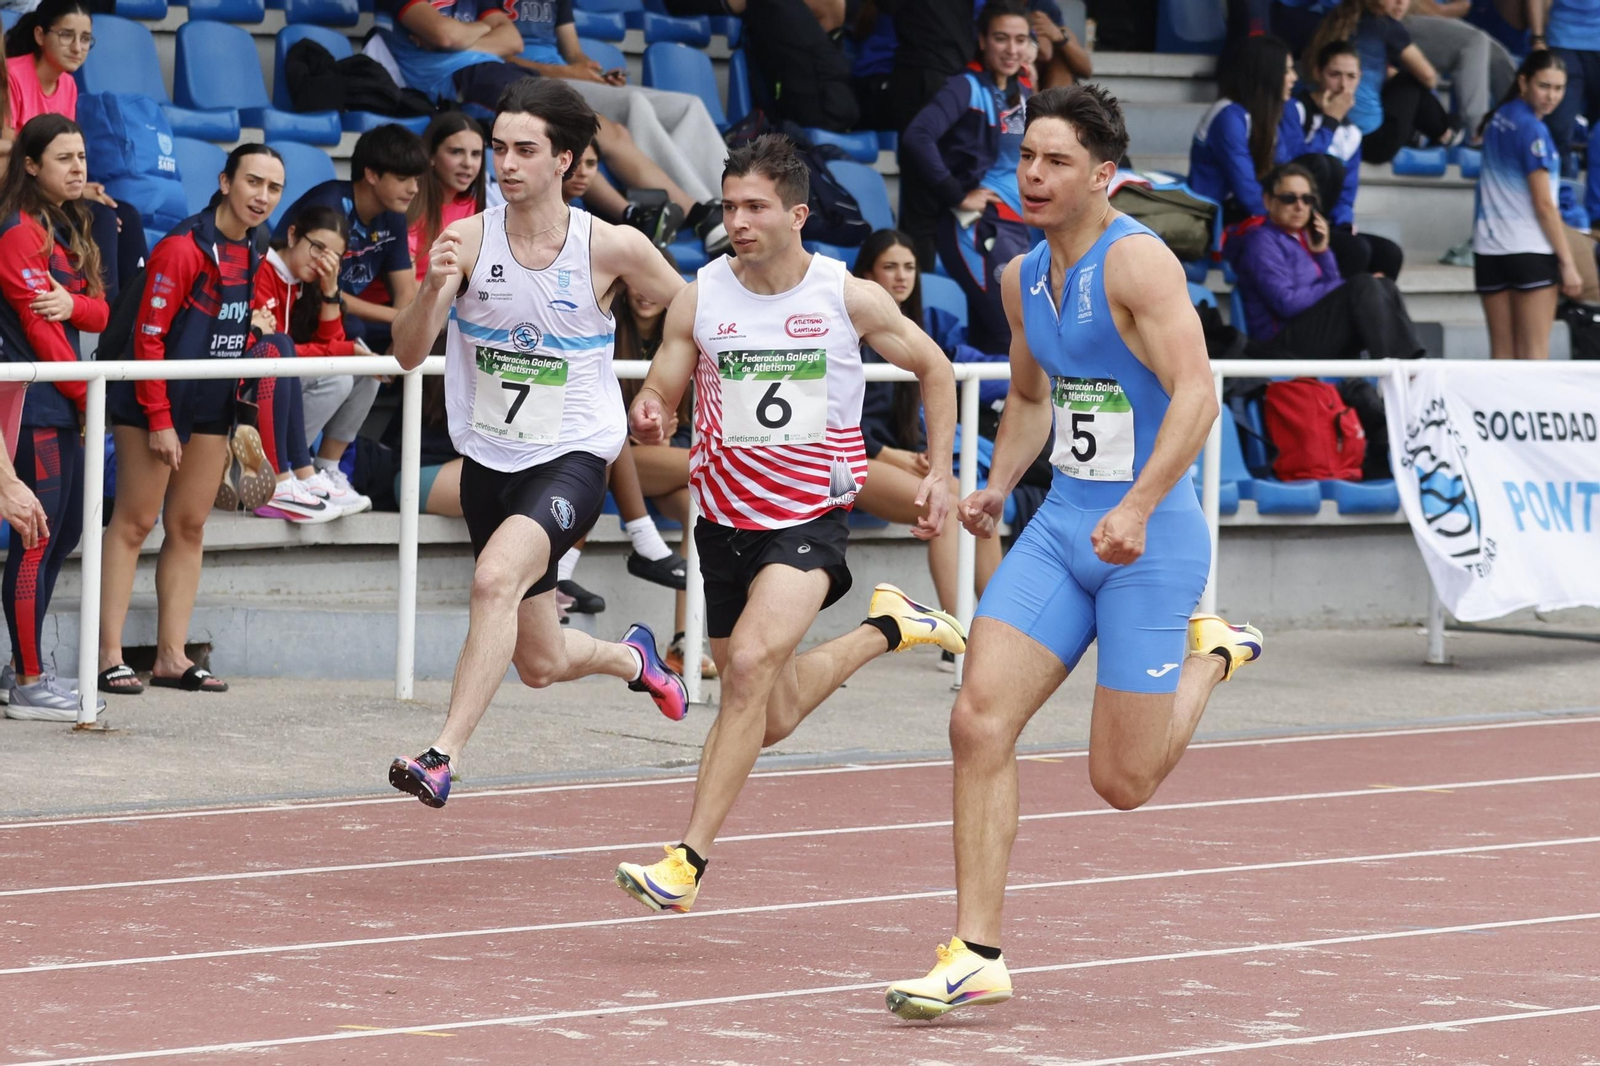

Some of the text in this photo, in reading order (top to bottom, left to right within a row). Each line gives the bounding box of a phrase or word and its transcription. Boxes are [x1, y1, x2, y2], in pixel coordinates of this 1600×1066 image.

[492, 351, 563, 370] Federación Galega
[741, 351, 820, 363] Federación Galega
[492, 362, 539, 375] de Atletismo
[753, 363, 795, 372] Atletismo
[501, 381, 531, 425] 7
[755, 382, 793, 429] 6
[475, 422, 508, 436] atletismo.gal
[1473, 411, 1597, 441] SOCIEDAD
[727, 434, 771, 444] atletismo.gal
[1071, 413, 1097, 463] 5
[1501, 481, 1600, 533] PONT
